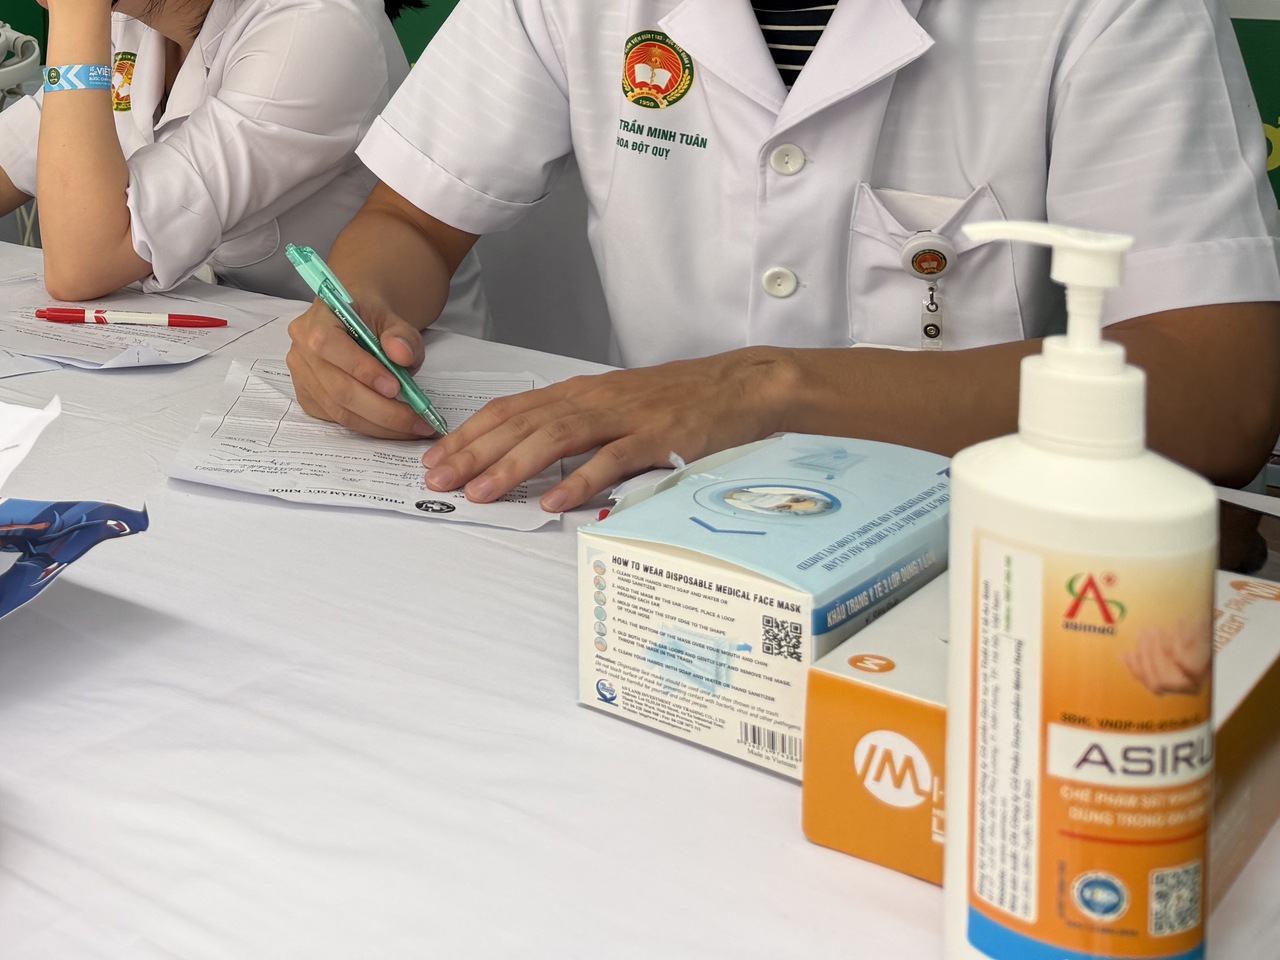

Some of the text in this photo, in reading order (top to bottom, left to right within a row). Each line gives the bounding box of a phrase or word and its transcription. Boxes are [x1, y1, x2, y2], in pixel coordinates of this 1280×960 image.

[646, 126, 677, 143] MINH
[631, 141, 671, 160] ĐỘT QUỴ
[611, 556, 801, 612] HOW TO WEAR DISPOSABLE MEDICAL FACE MASK
